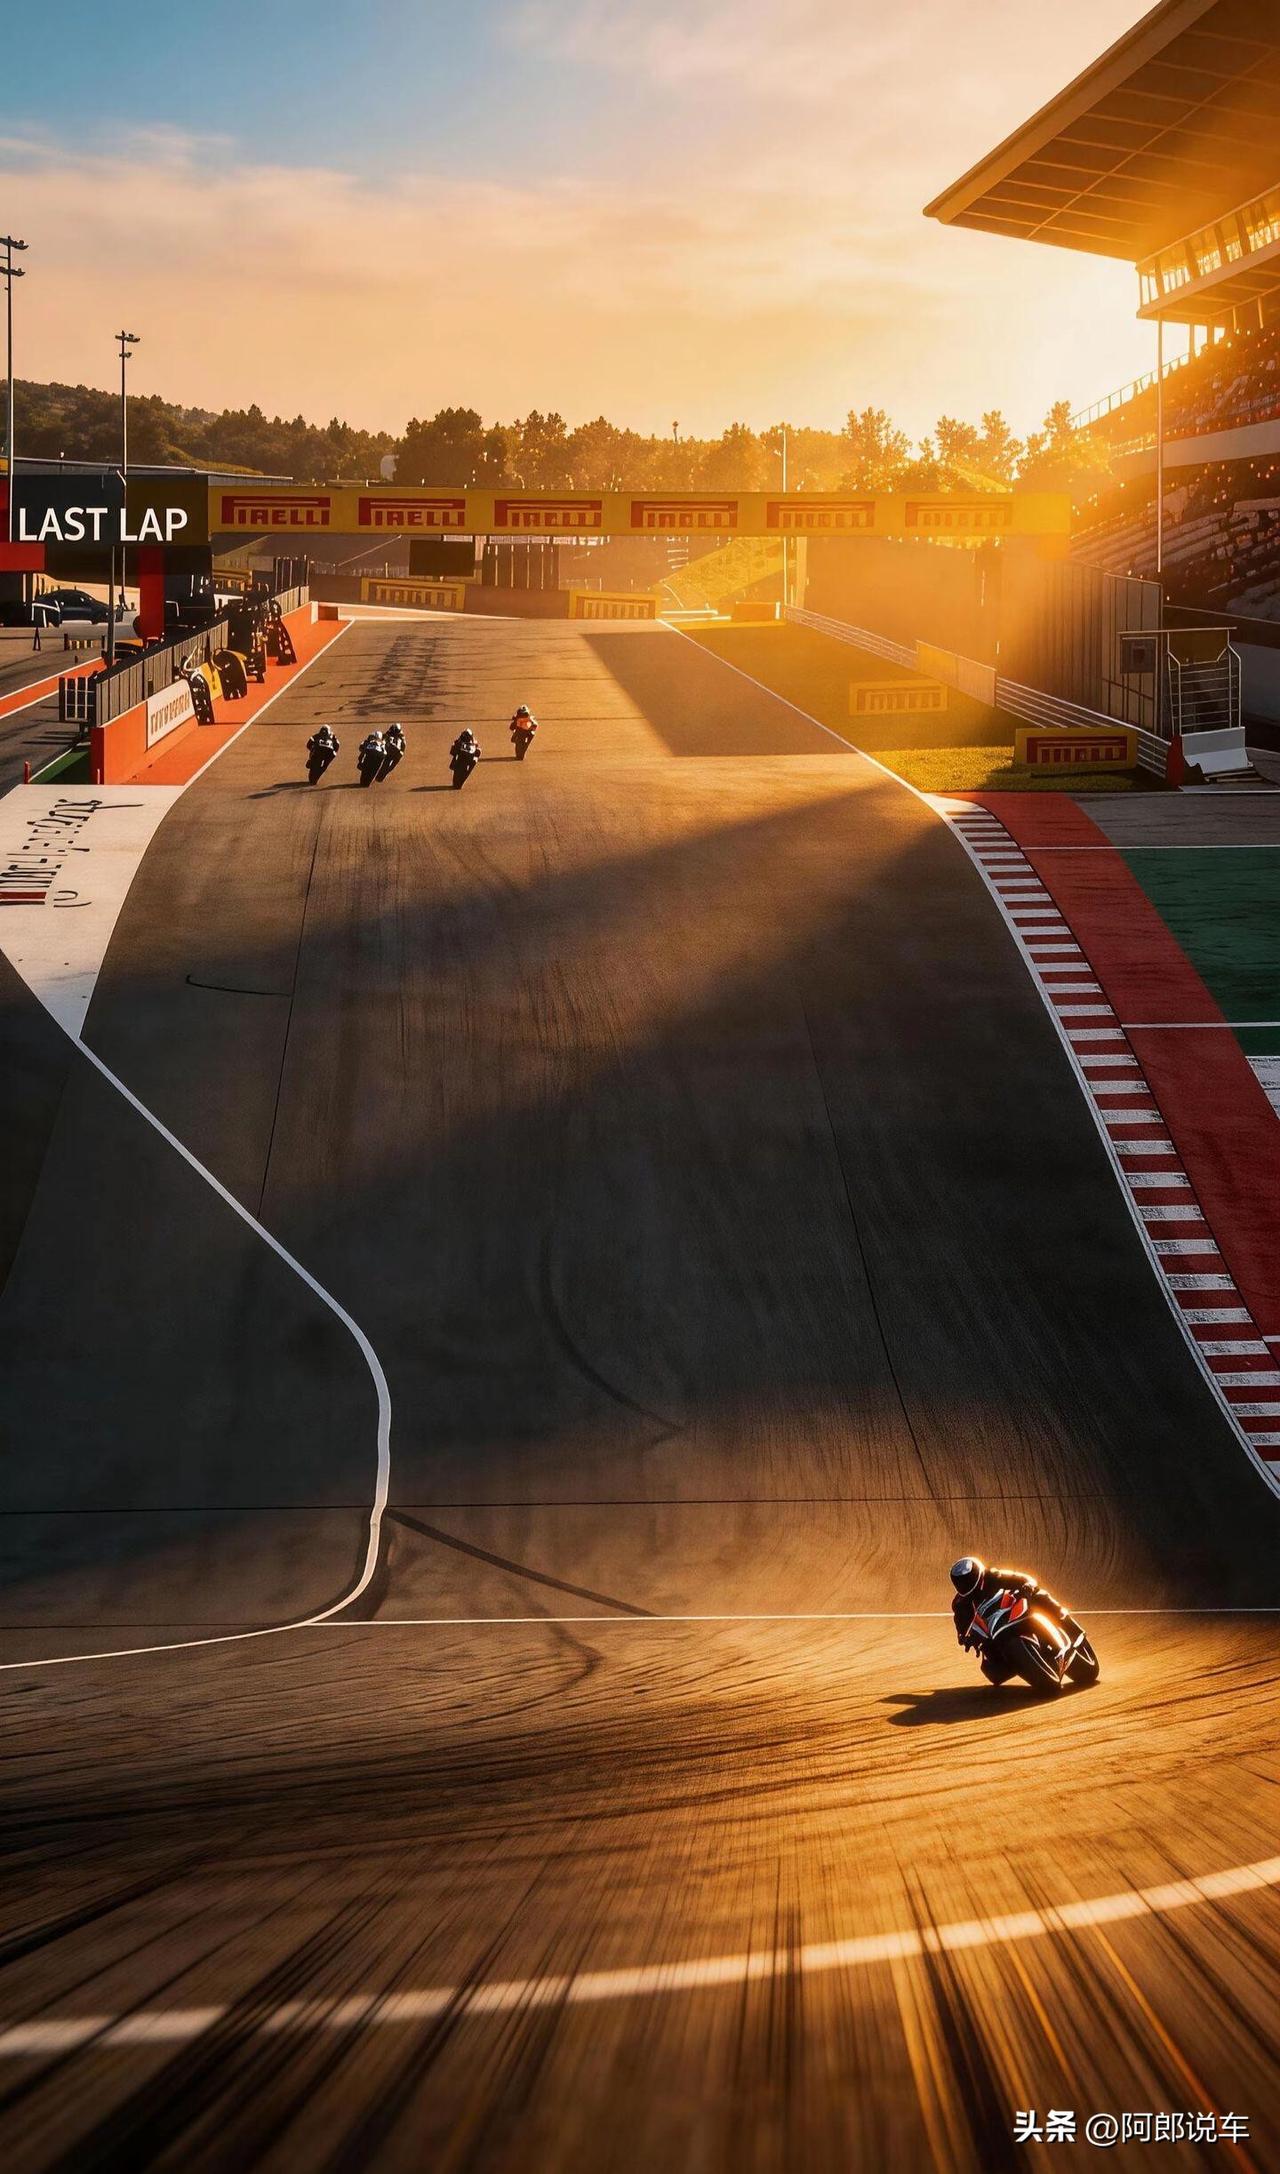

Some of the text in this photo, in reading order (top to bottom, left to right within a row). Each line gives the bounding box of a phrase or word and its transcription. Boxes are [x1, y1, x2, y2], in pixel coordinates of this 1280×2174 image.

[19, 507, 189, 542] LAST LAP
[221, 495, 331, 525] PIRELLI
[358, 497, 466, 527] PIRELLI
